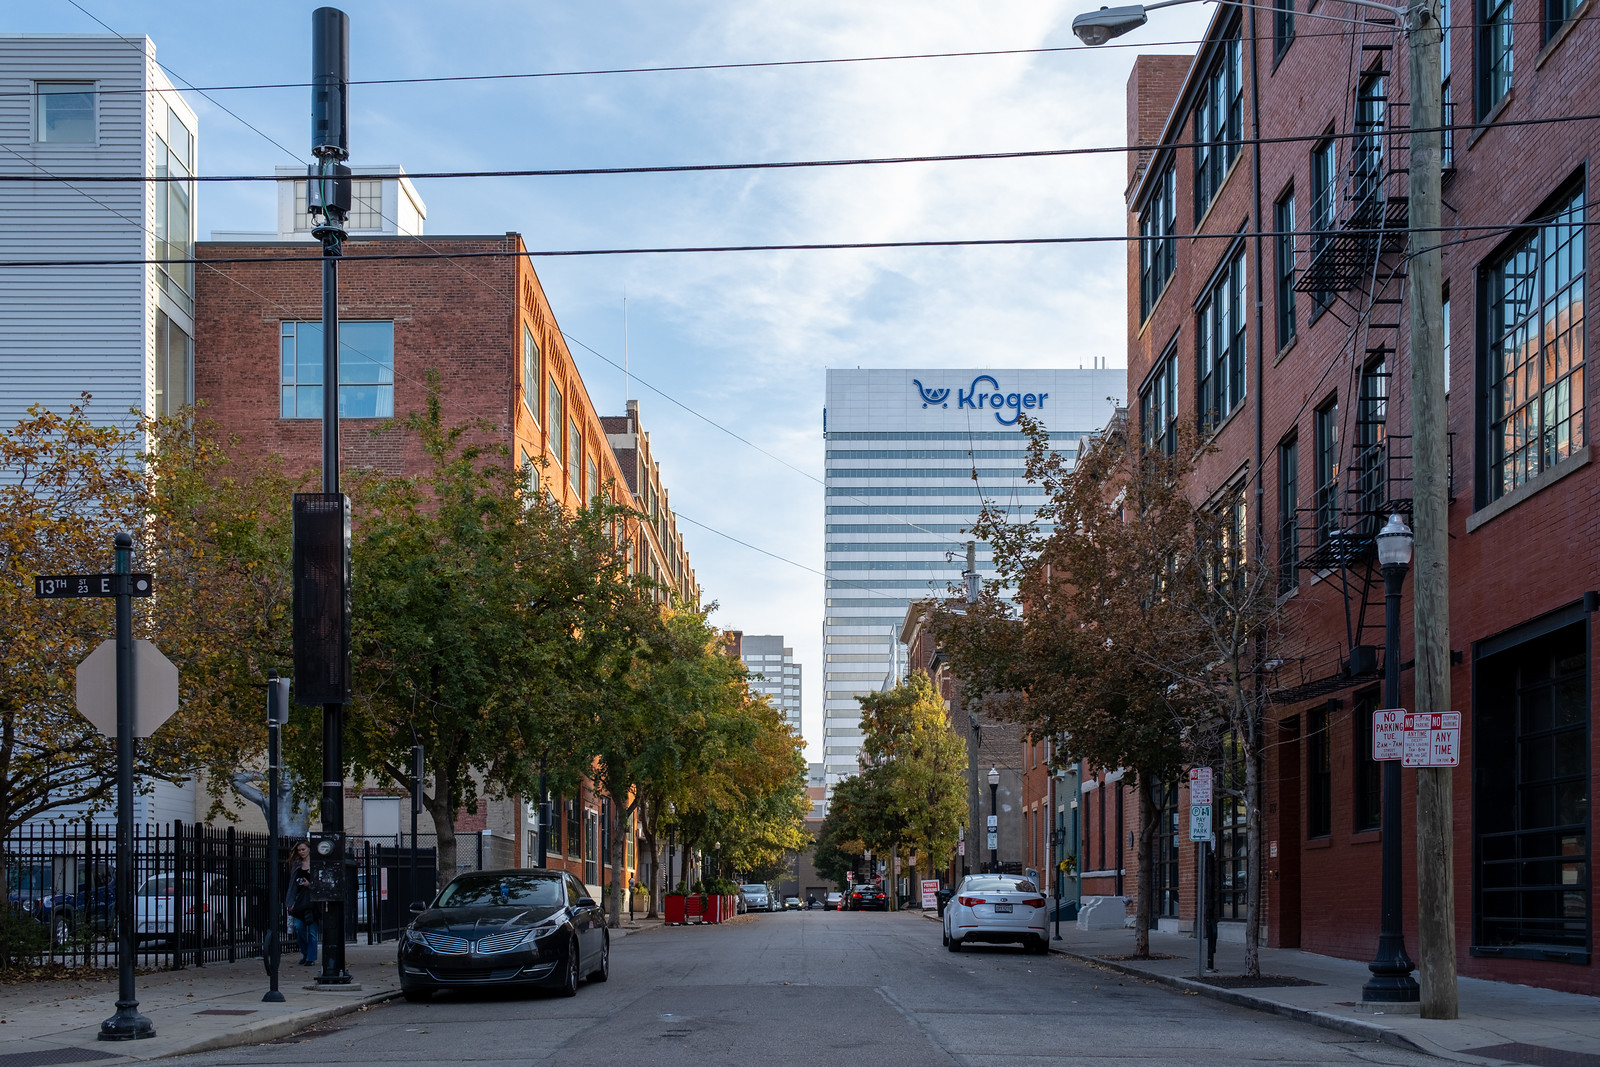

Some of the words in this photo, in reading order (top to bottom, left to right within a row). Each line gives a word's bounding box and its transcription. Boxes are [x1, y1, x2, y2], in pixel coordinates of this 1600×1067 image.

[958, 375, 1048, 425] Kroger
[40, 579, 67, 594] 13TH
[101, 578, 110, 593] E
[78, 585, 89, 593] 23
[1384, 713, 1396, 722] NO
[1432, 716, 1440, 727] NO
[1376, 723, 1403, 732] PARKING
[1405, 718, 1413, 728] NO
[1436, 732, 1452, 742] ANY
[1435, 744, 1452, 755] TIME
